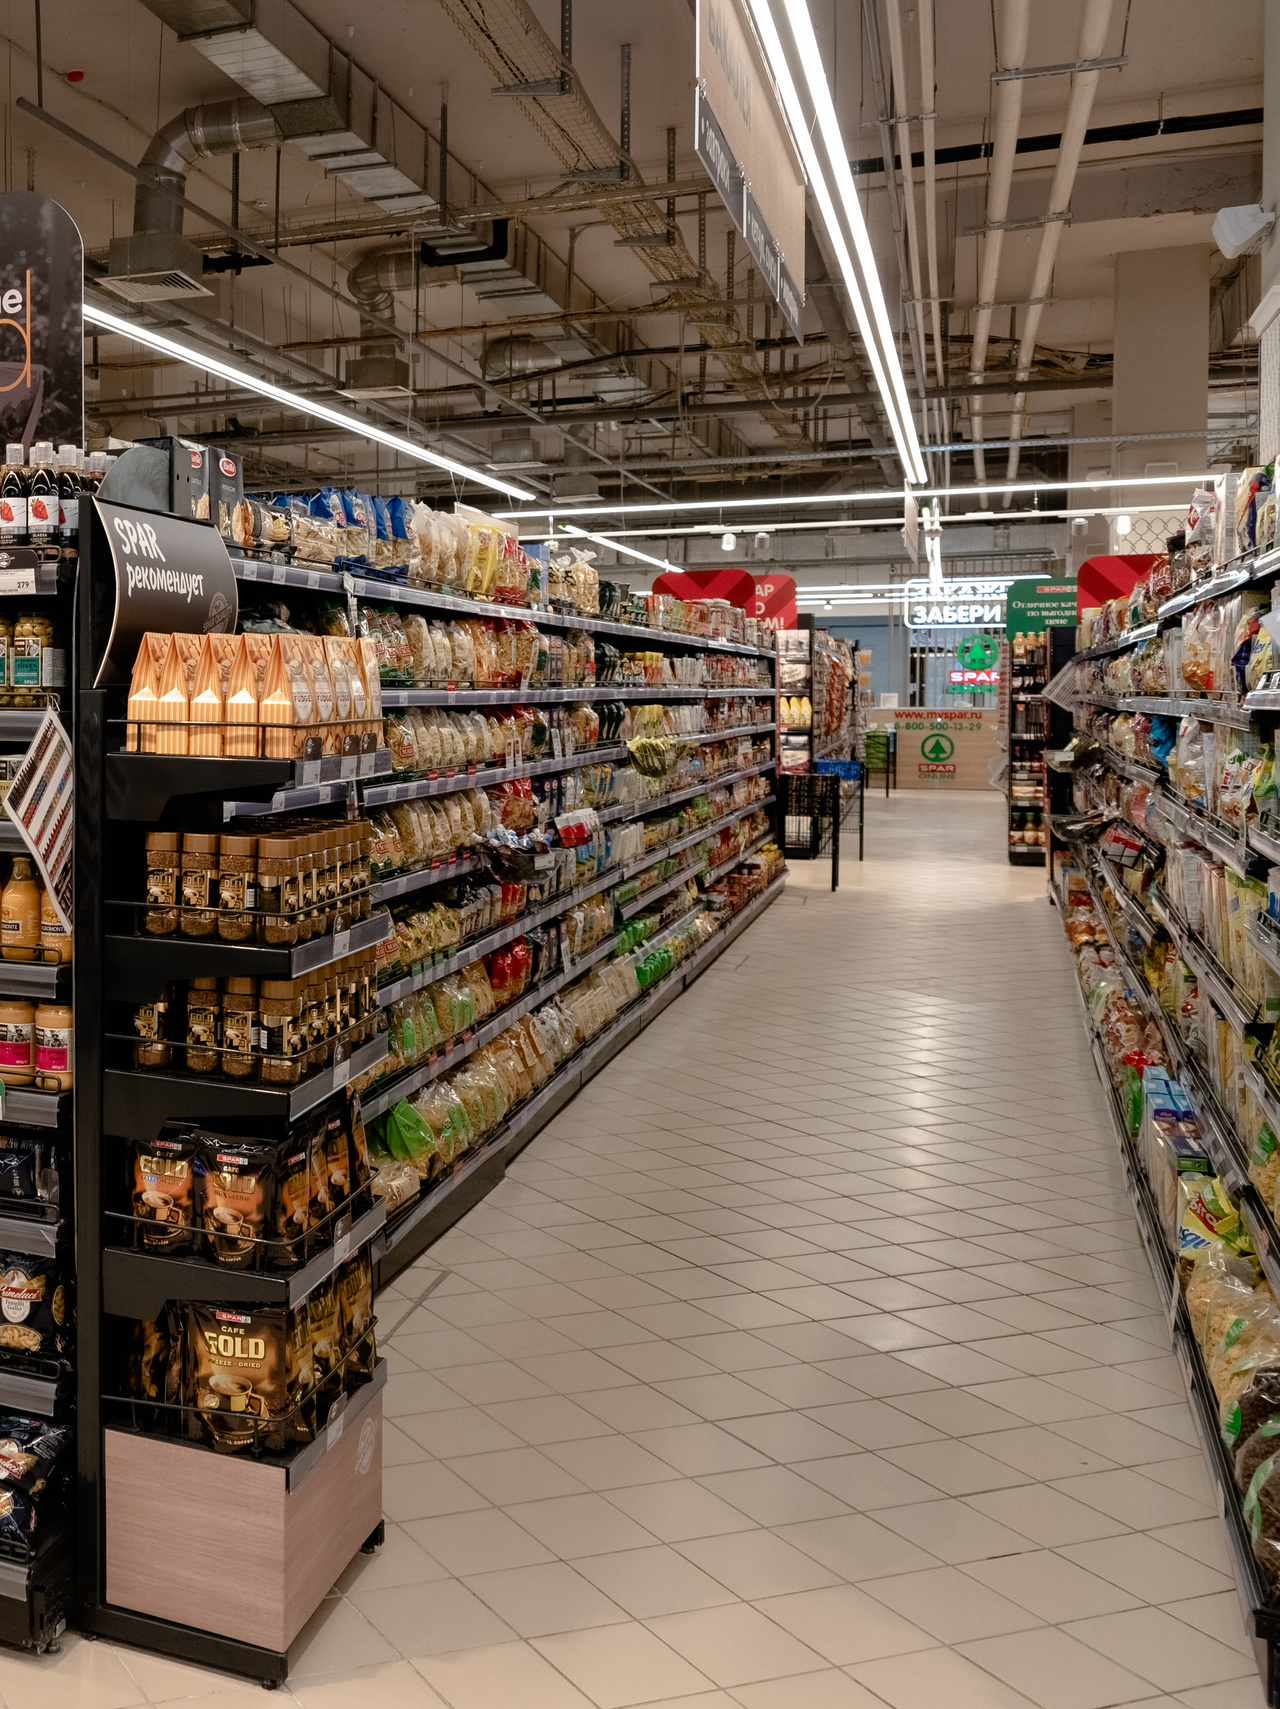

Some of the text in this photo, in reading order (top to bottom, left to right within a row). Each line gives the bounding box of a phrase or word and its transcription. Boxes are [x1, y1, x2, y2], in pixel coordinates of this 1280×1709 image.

[112, 516, 166, 563] SPAR
[125, 561, 205, 604] рекомендует
[1012, 601, 1060, 609] Отличное
[913, 603, 1002, 624] ЗАБЕРИ
[1041, 610, 1078, 619] выгодно
[1045, 618, 1068, 627] цене
[919, 764, 955, 772] SPAR
[140, 1155, 189, 1179] GOLD
[221, 1313, 242, 1323] SPAR
[221, 1326, 246, 1336] CAFE
[204, 1331, 266, 1360] GOLD
[237, 1360, 262, 1369] DRIED
